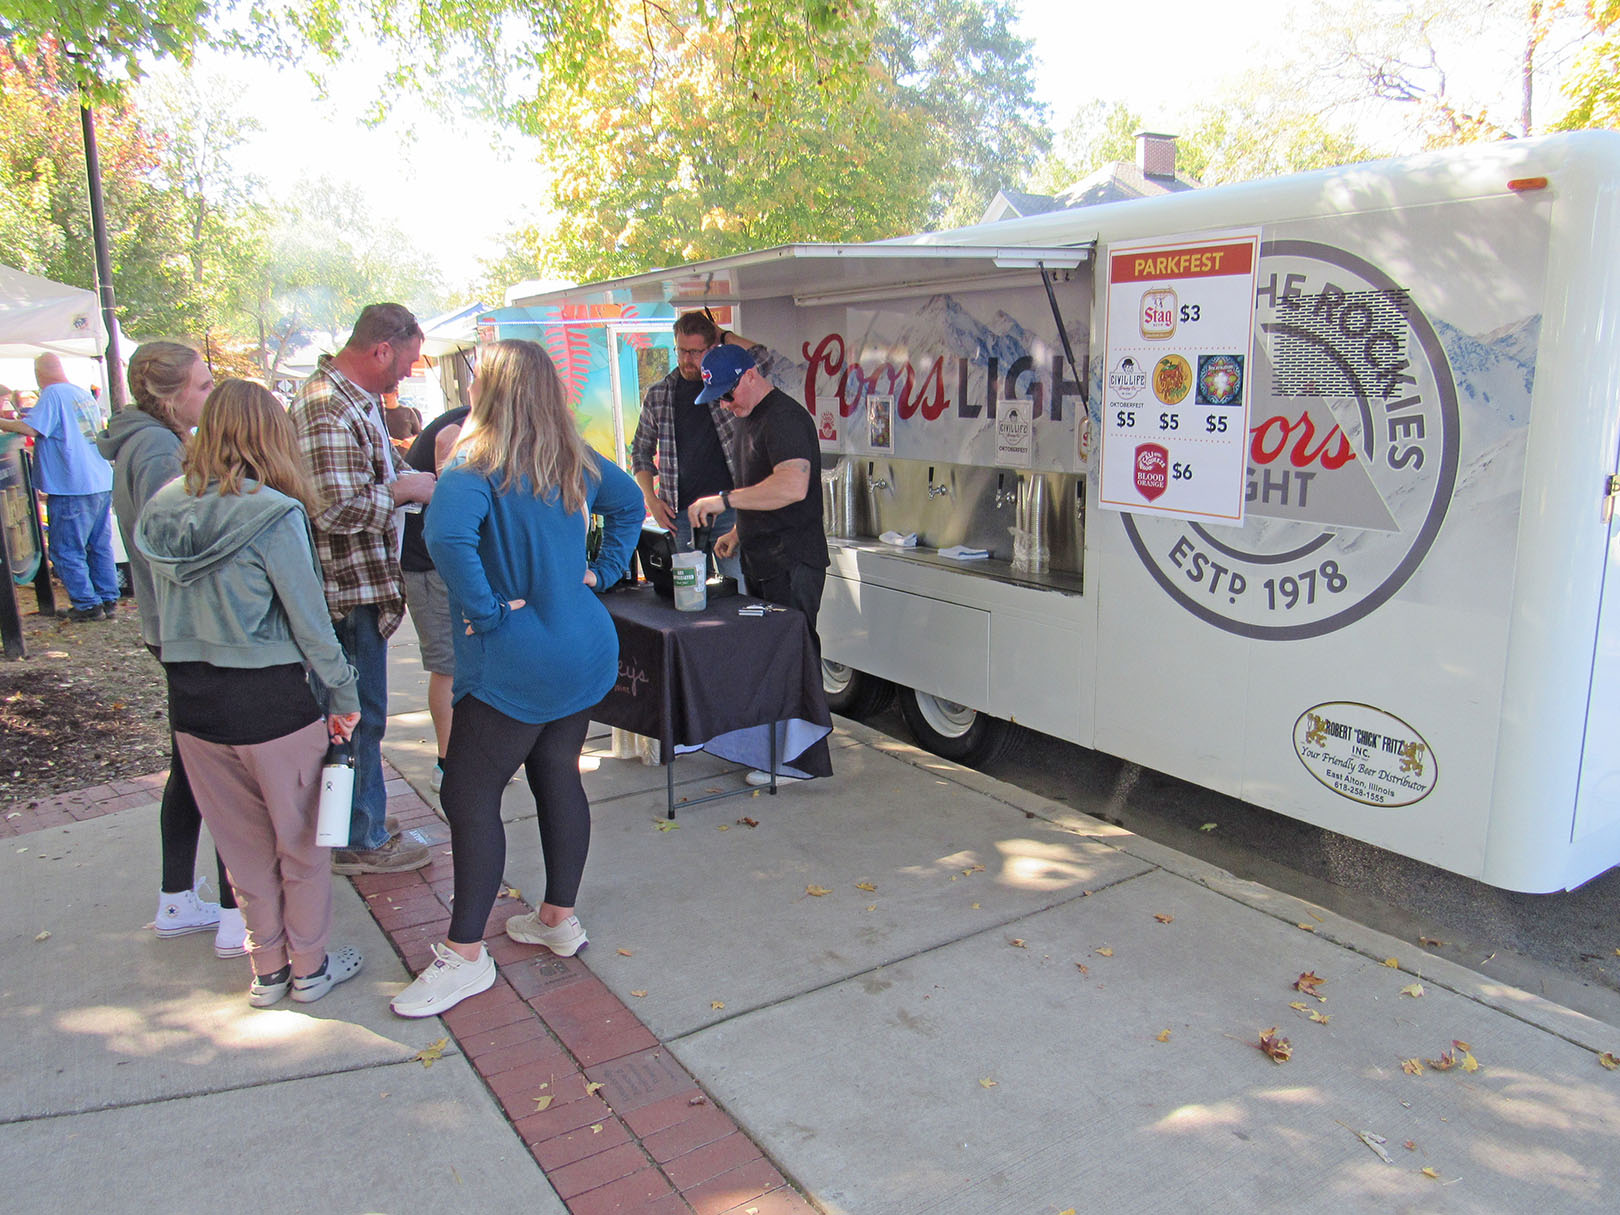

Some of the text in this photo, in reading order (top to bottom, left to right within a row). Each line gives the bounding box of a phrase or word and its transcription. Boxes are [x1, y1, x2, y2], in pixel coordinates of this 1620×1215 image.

[1134, 252, 1224, 276] PARKFEST
[1257, 273, 1307, 310] HE
[1144, 306, 1172, 327] Stag
[1180, 304, 1200, 323] $3
[802, 333, 1089, 421] Coors LIGH
[1116, 411, 1135, 428] $5
[1159, 412, 1179, 430] $5
[1206, 414, 1228, 433] $5
[1250, 410, 1356, 470] ors
[1137, 472, 1165, 482] BLOOD
[1172, 462, 1193, 480] $6
[1137, 480, 1165, 488] ORANGE
[1263, 560, 1348, 610] 1978
[1326, 719, 1352, 741] ROBERT
[1352, 746, 1370, 758] INC.
[1302, 746, 1427, 792] Your Friendly Beer Distributor
[1326, 769, 1343, 780] East
[1368, 783, 1395, 797] Illinois
[1334, 781, 1384, 803] 618-258-1555
